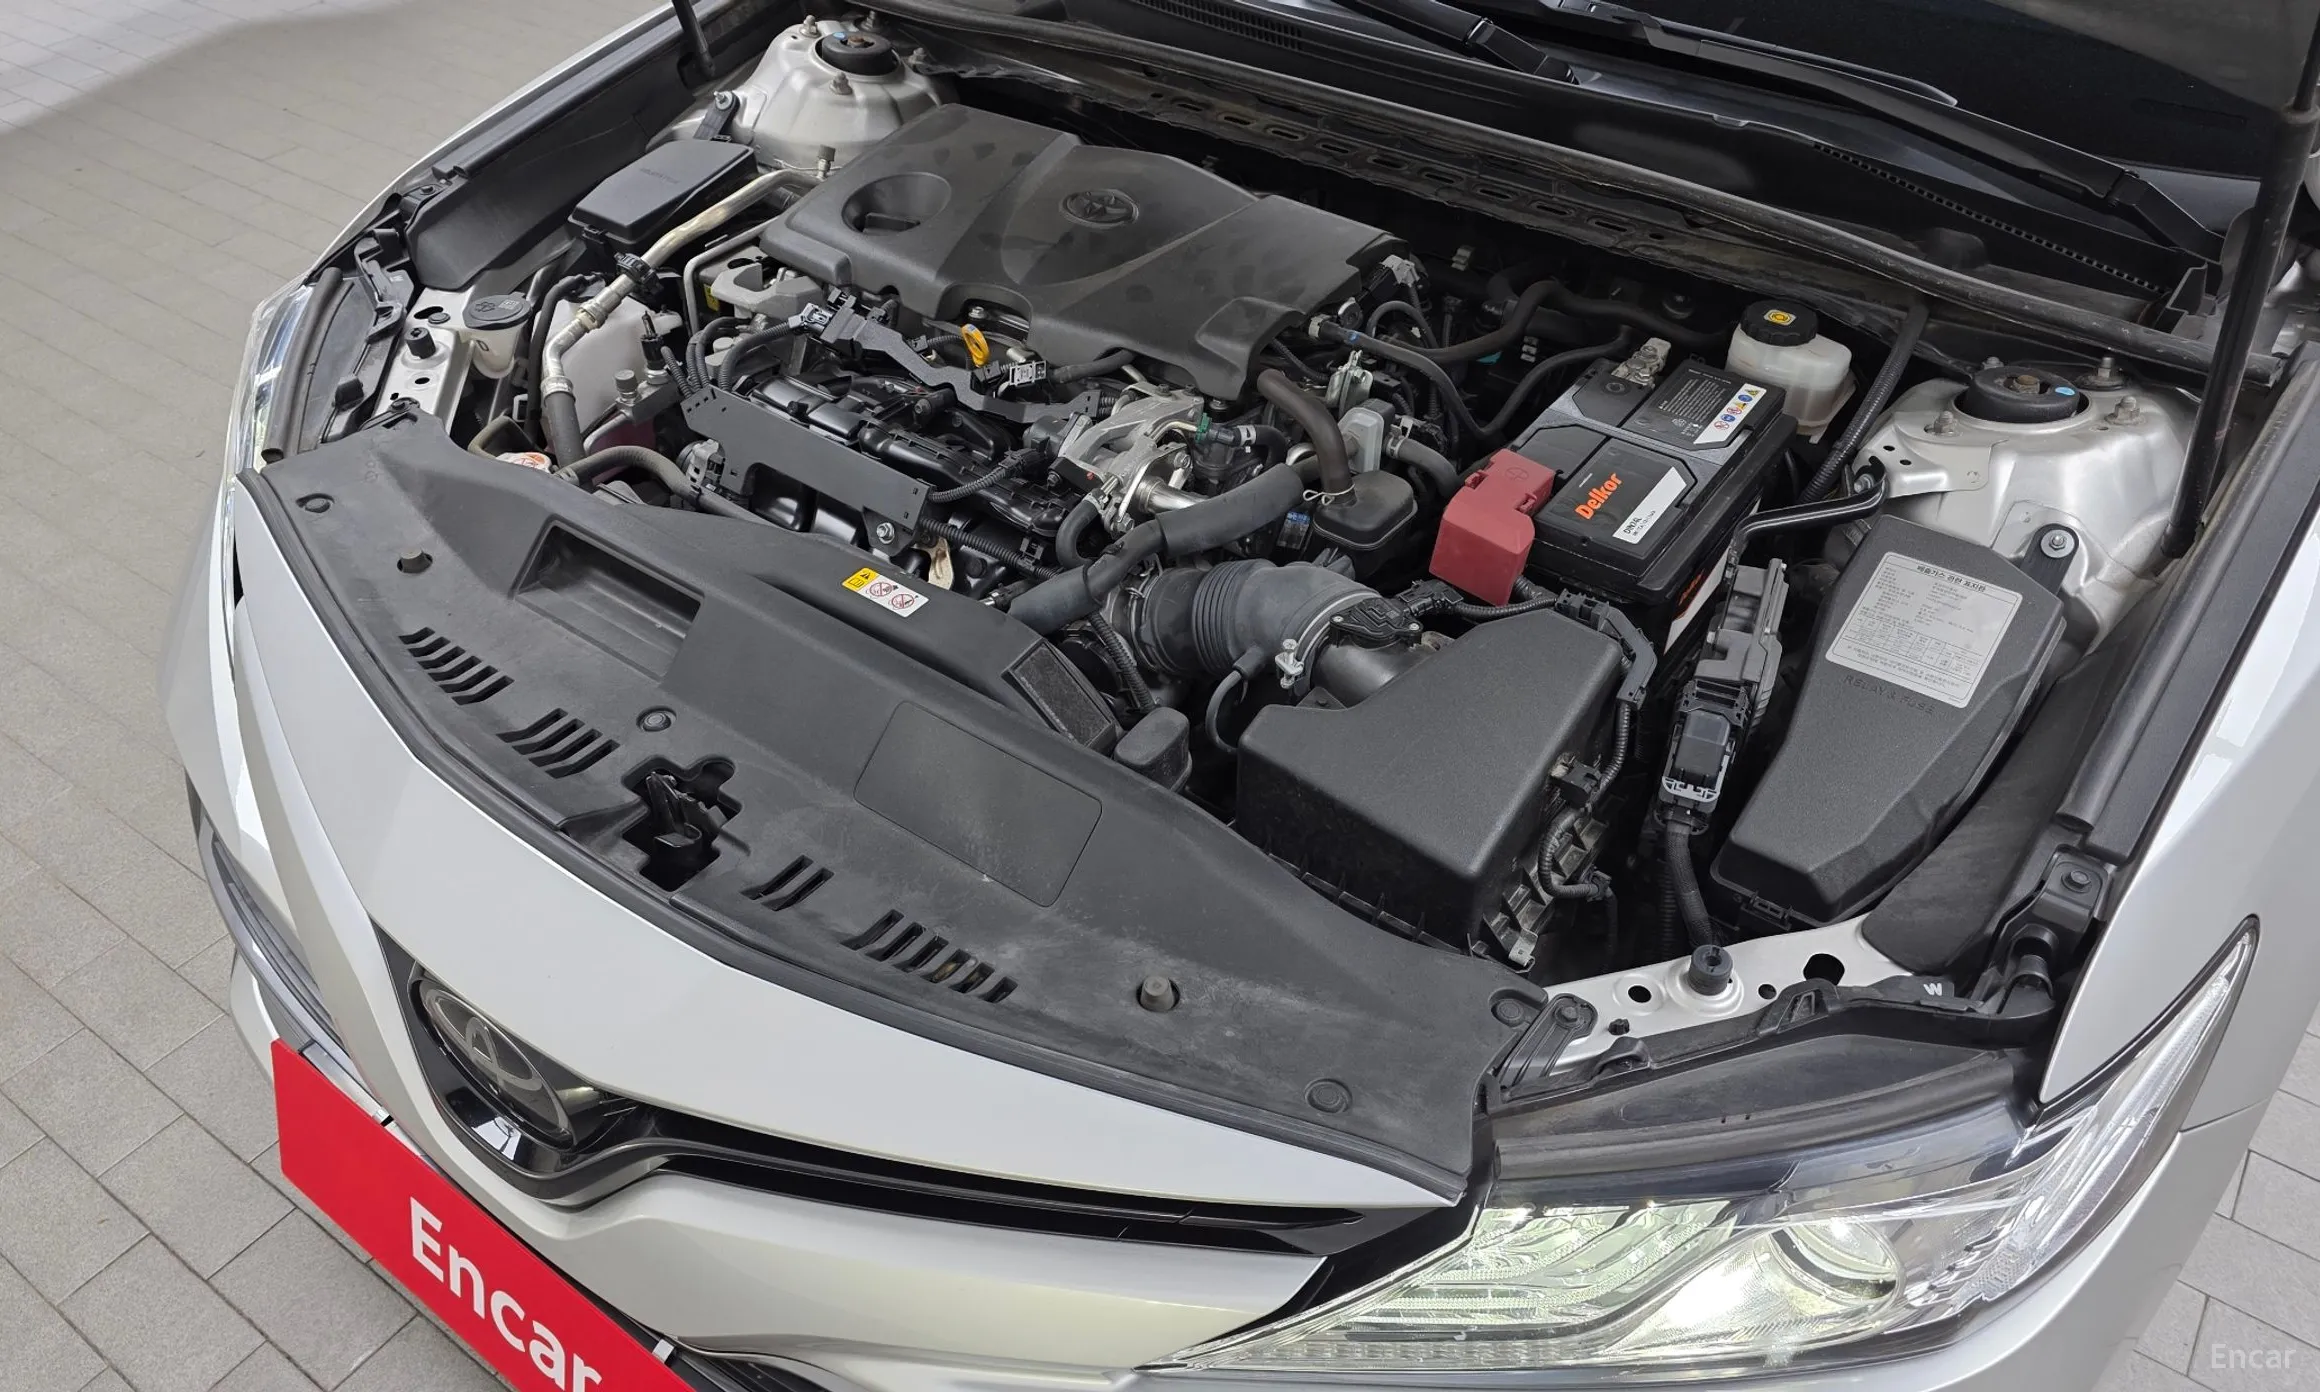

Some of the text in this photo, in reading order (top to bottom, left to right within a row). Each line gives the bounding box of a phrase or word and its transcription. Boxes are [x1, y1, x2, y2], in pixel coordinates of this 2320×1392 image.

[1575, 473, 1622, 519] Delkor
[1916, 565, 1986, 593] 배출가스 관련 표지판
[1843, 674, 1887, 696] RELAY
[1899, 694, 1935, 715] FUSE
[410, 1196, 602, 1392] Encar
